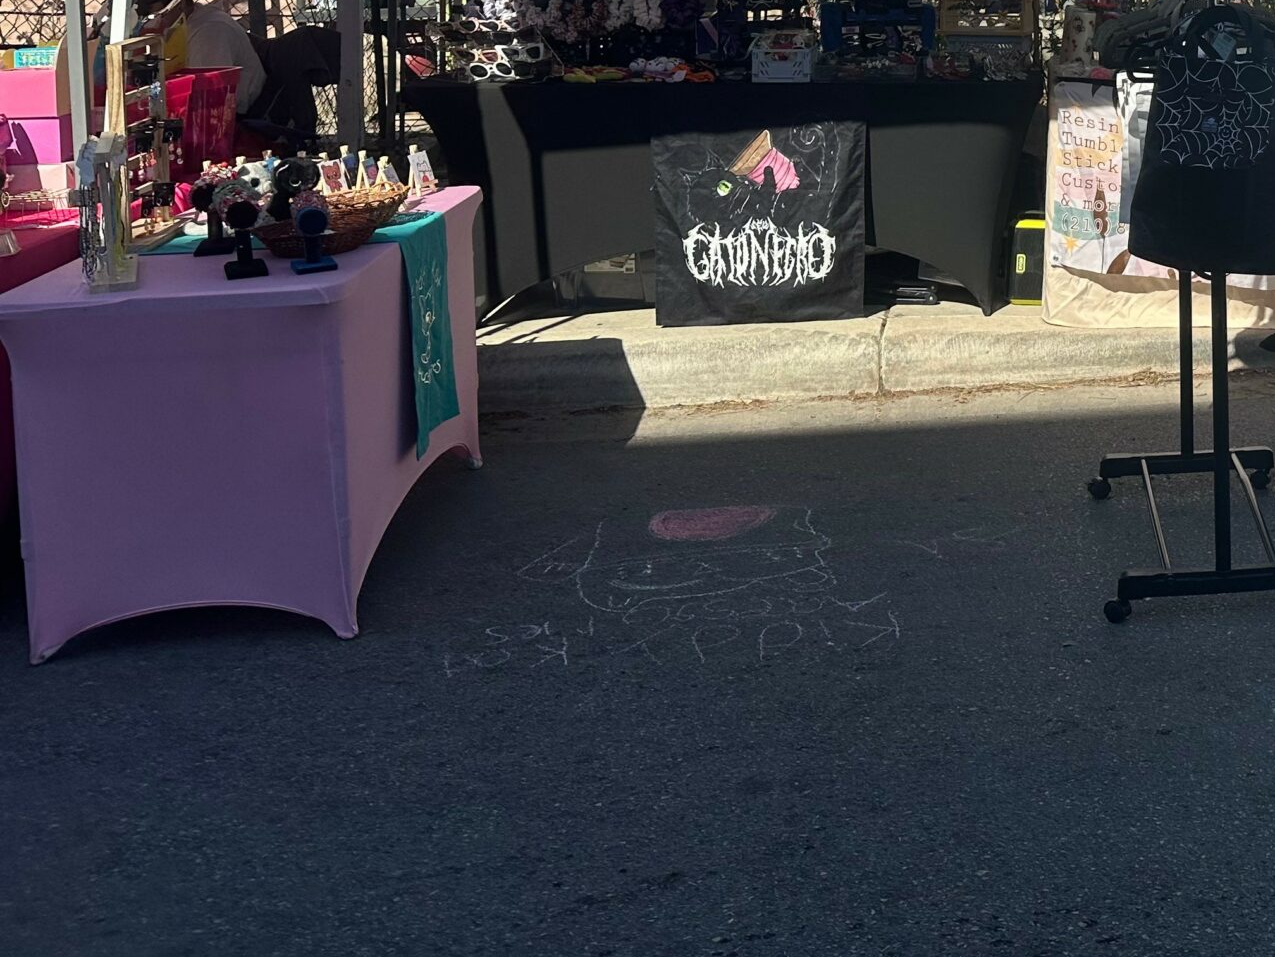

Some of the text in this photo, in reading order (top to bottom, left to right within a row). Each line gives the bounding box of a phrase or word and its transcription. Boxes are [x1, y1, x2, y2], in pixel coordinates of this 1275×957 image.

[1061, 110, 1120, 134] Resin
[1062, 131, 1119, 153] Tumbl
[1063, 152, 1119, 174] Stick
[1061, 172, 1119, 192] Custo
[1061, 193, 1118, 213] & mor
